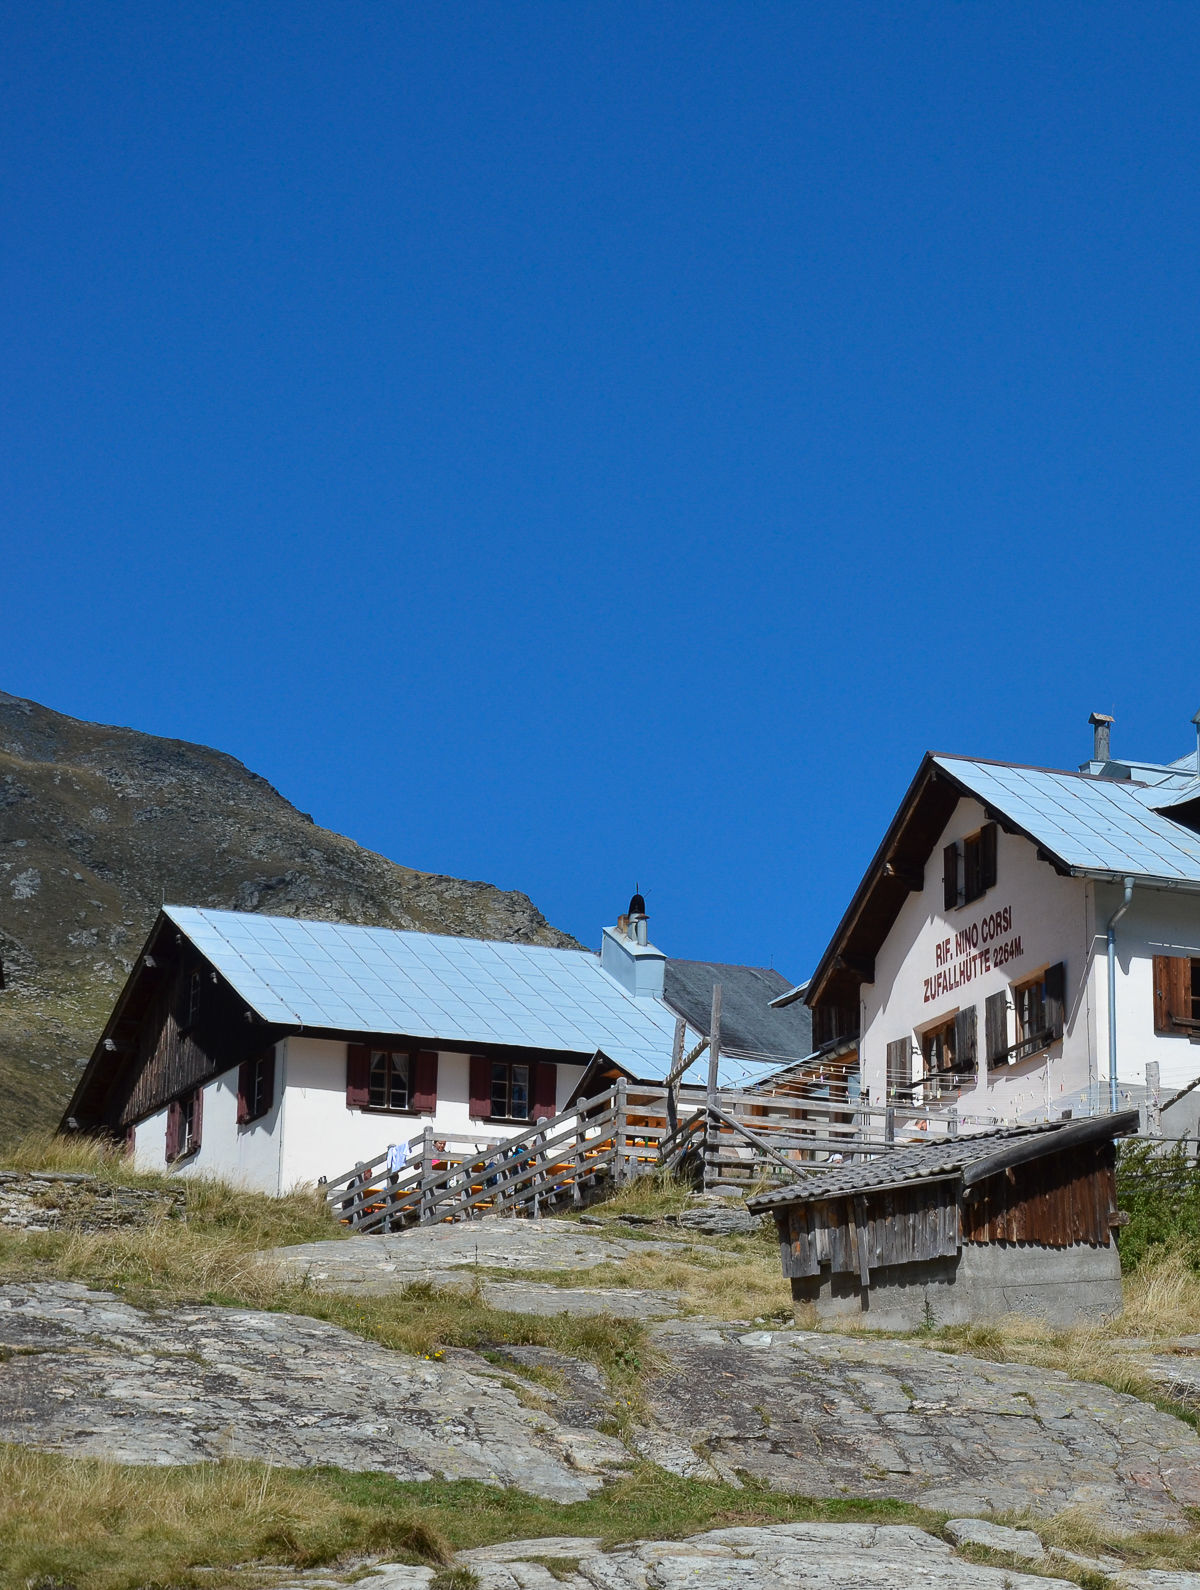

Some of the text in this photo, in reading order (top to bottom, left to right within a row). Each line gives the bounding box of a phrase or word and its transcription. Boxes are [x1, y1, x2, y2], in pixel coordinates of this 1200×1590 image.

[923, 935, 1024, 1003] ZUFALLHÜTTE 2264M.
[935, 905, 1012, 968] RIF. NINO CORSI
